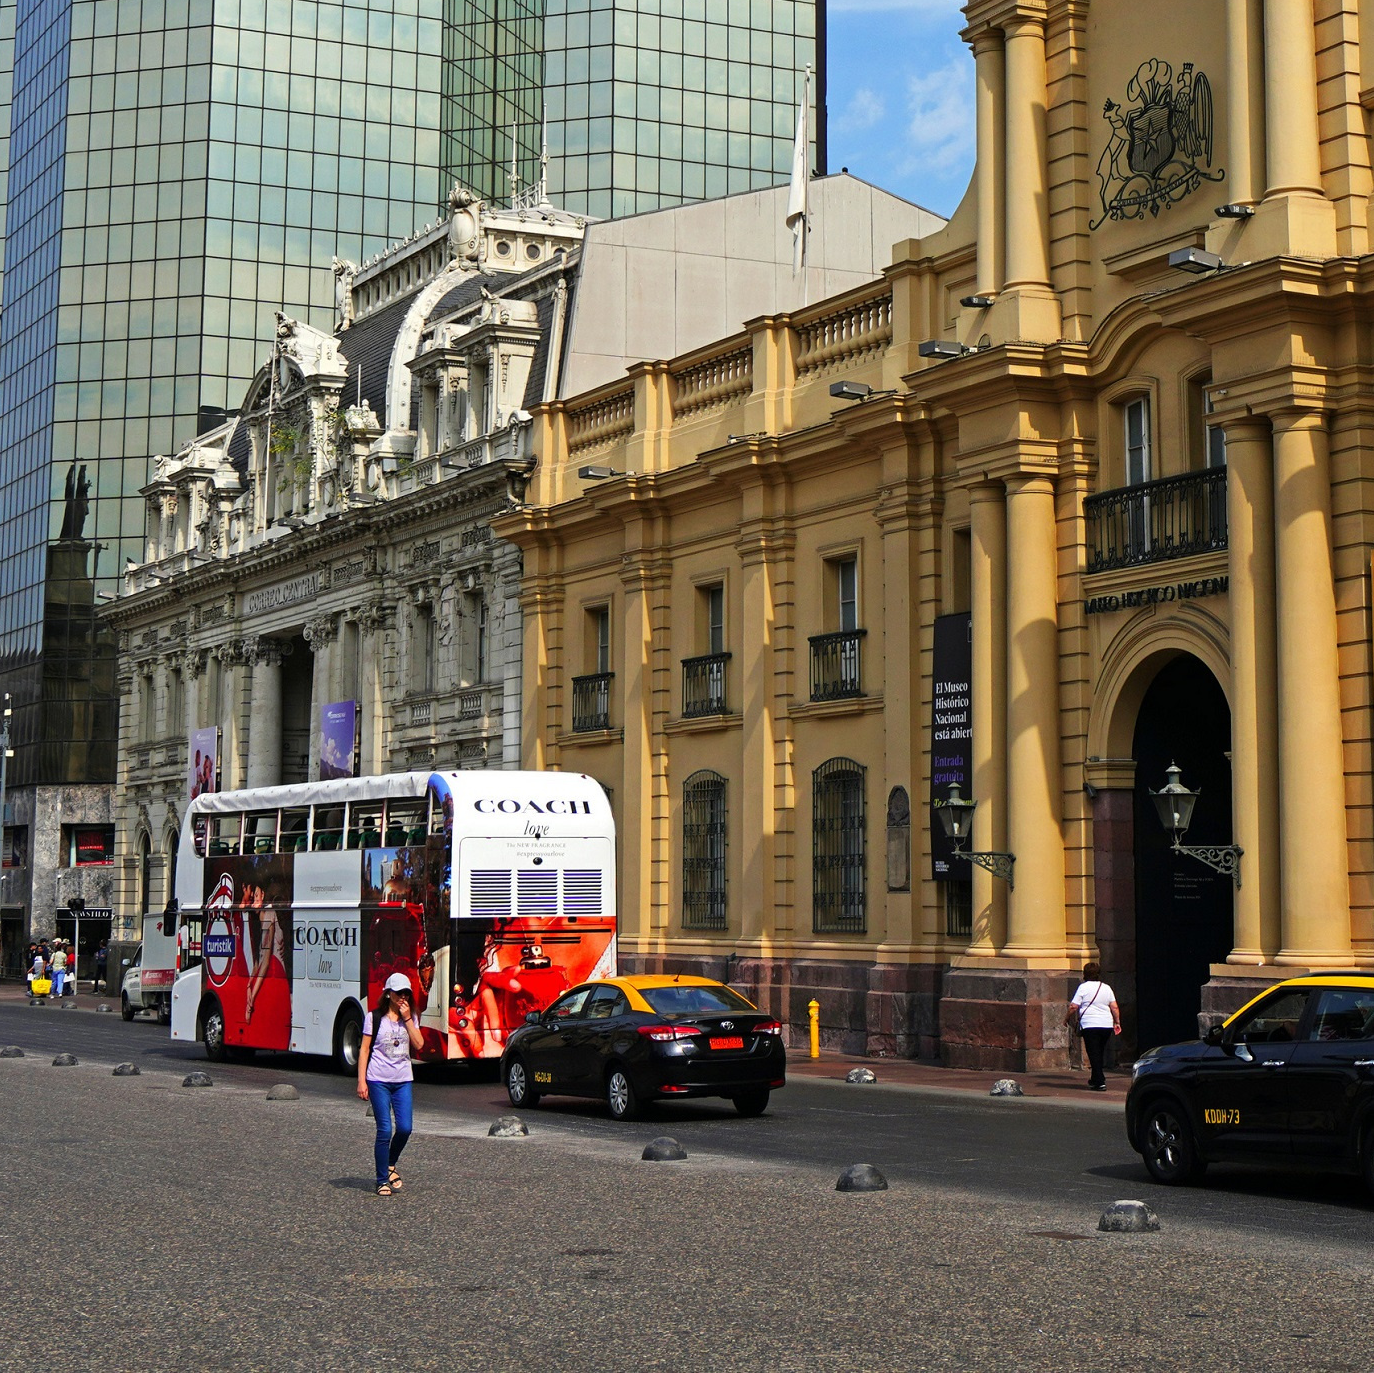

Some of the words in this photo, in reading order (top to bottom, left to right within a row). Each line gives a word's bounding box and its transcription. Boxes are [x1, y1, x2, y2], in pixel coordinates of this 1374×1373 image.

[249, 587, 281, 613] CORREO
[935, 682, 943, 694] El
[944, 681, 968, 694] Museo
[935, 696, 969, 710] Histórico
[935, 711, 967, 725] Nacional
[934, 728, 950, 740] está
[950, 726, 973, 740] abiert
[934, 755, 964, 767] Entrada
[933, 770, 964, 785] gratuita
[473, 798, 593, 815] COACH
[524, 820, 550, 836] love
[295, 926, 358, 947] COACH
[207, 939, 232, 953] turistik
[318, 954, 333, 974] love
